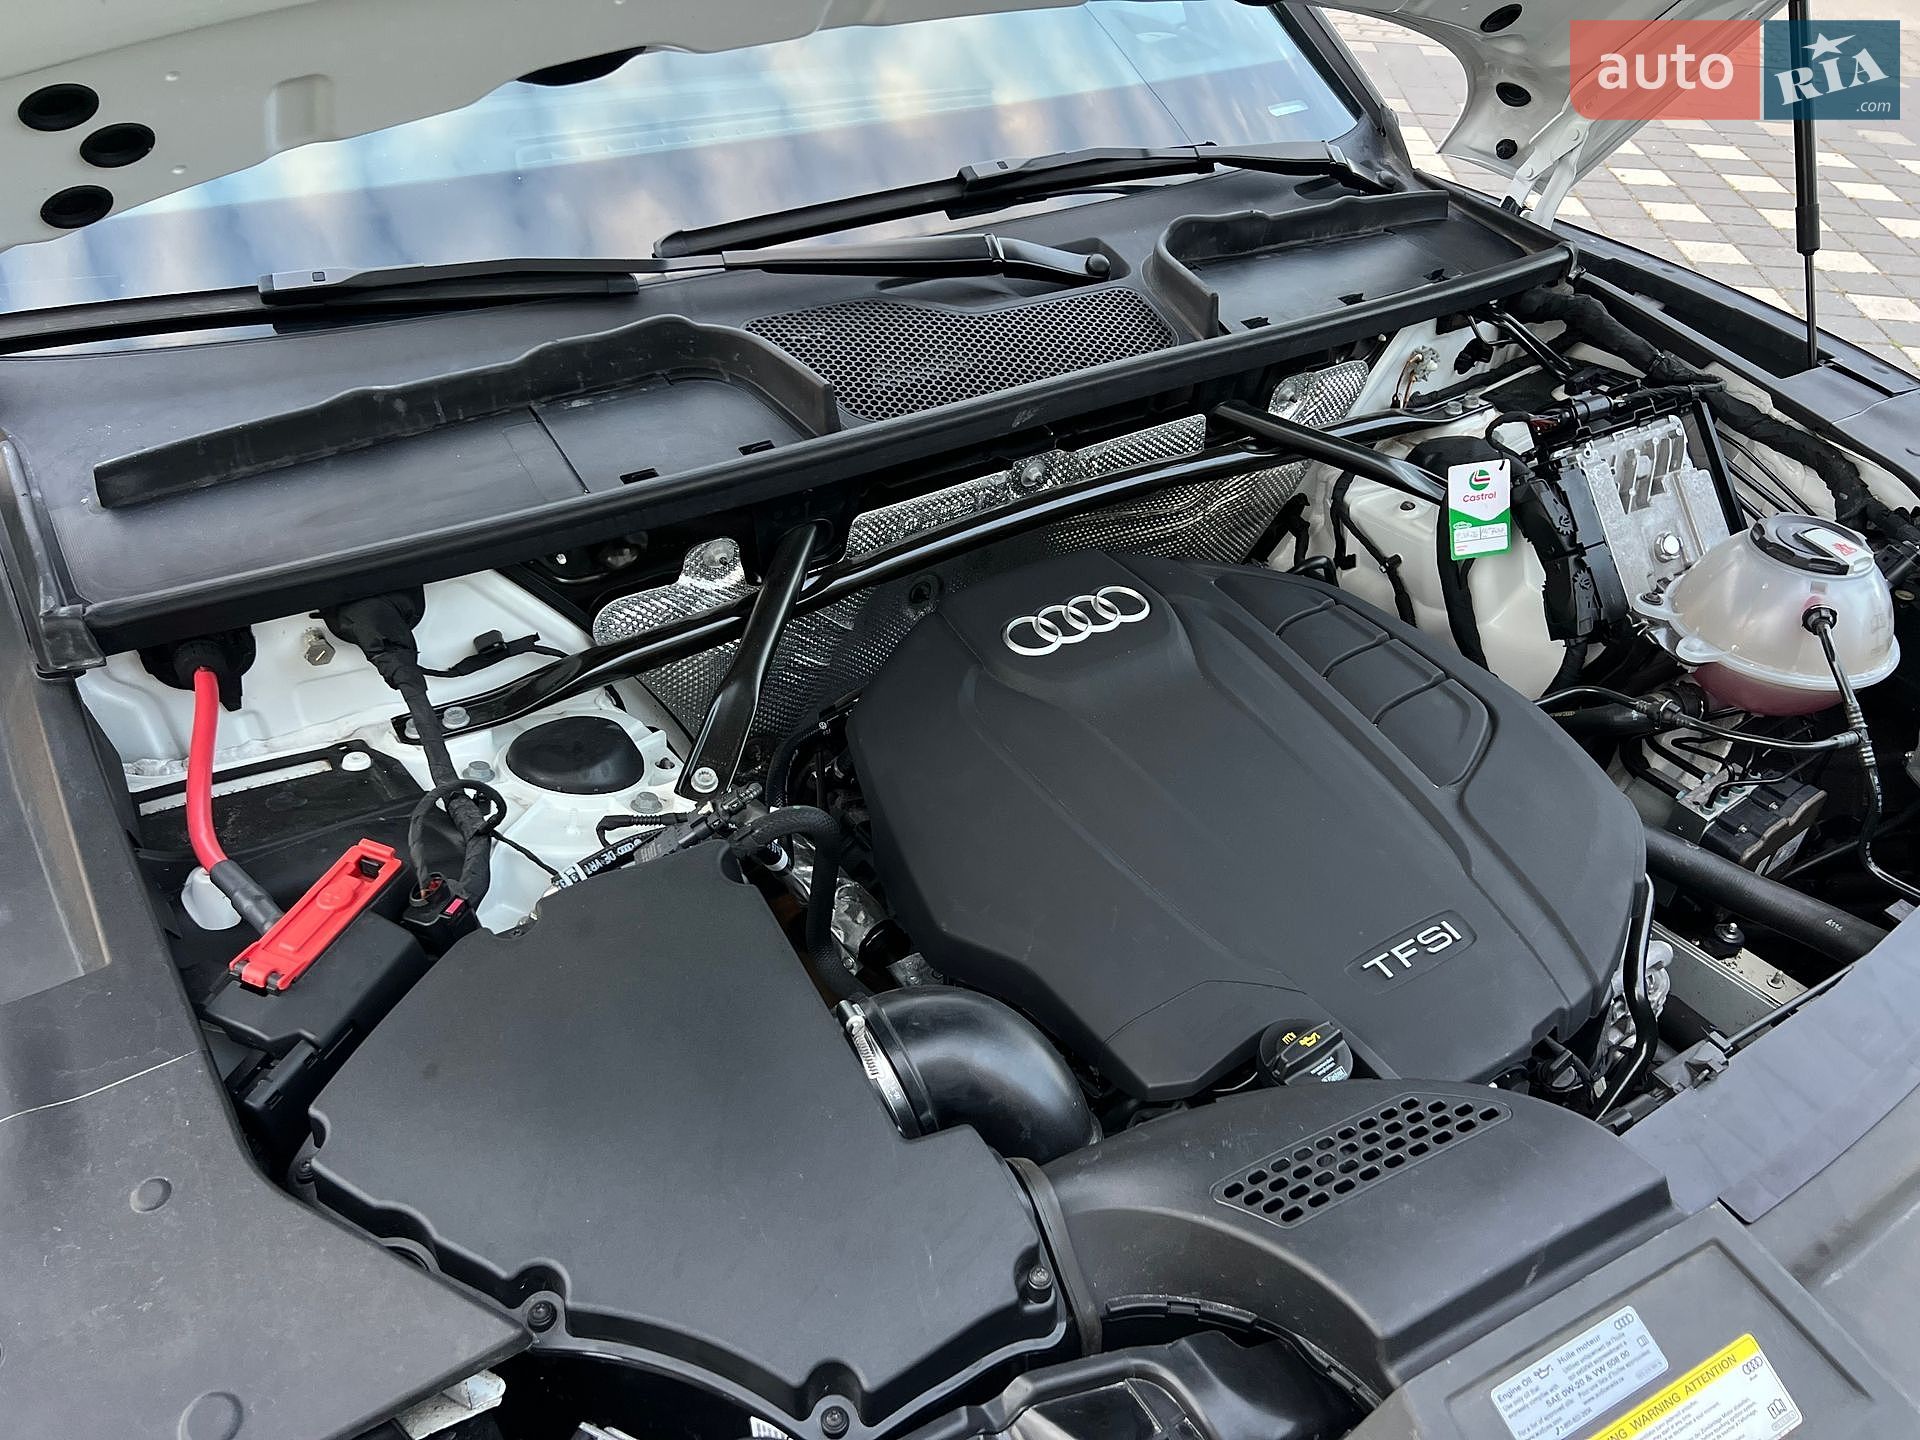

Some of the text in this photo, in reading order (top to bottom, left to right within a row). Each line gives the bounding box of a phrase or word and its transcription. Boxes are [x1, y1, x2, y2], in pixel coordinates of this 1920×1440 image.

[1463, 492, 1496, 503] Castrol
[1362, 921, 1462, 978] TFSI
[1557, 1335, 1601, 1364] Huile moteur
[1497, 1376, 1533, 1402] Engine Oil
[1545, 1393, 1561, 1407] SAE
[1585, 1374, 1592, 1382] &
[1592, 1364, 1606, 1377] VW
[1620, 1350, 1630, 1360] 00
[1629, 1392, 1681, 1431] WARNING
[1684, 1354, 1737, 1396] ATTENTION
